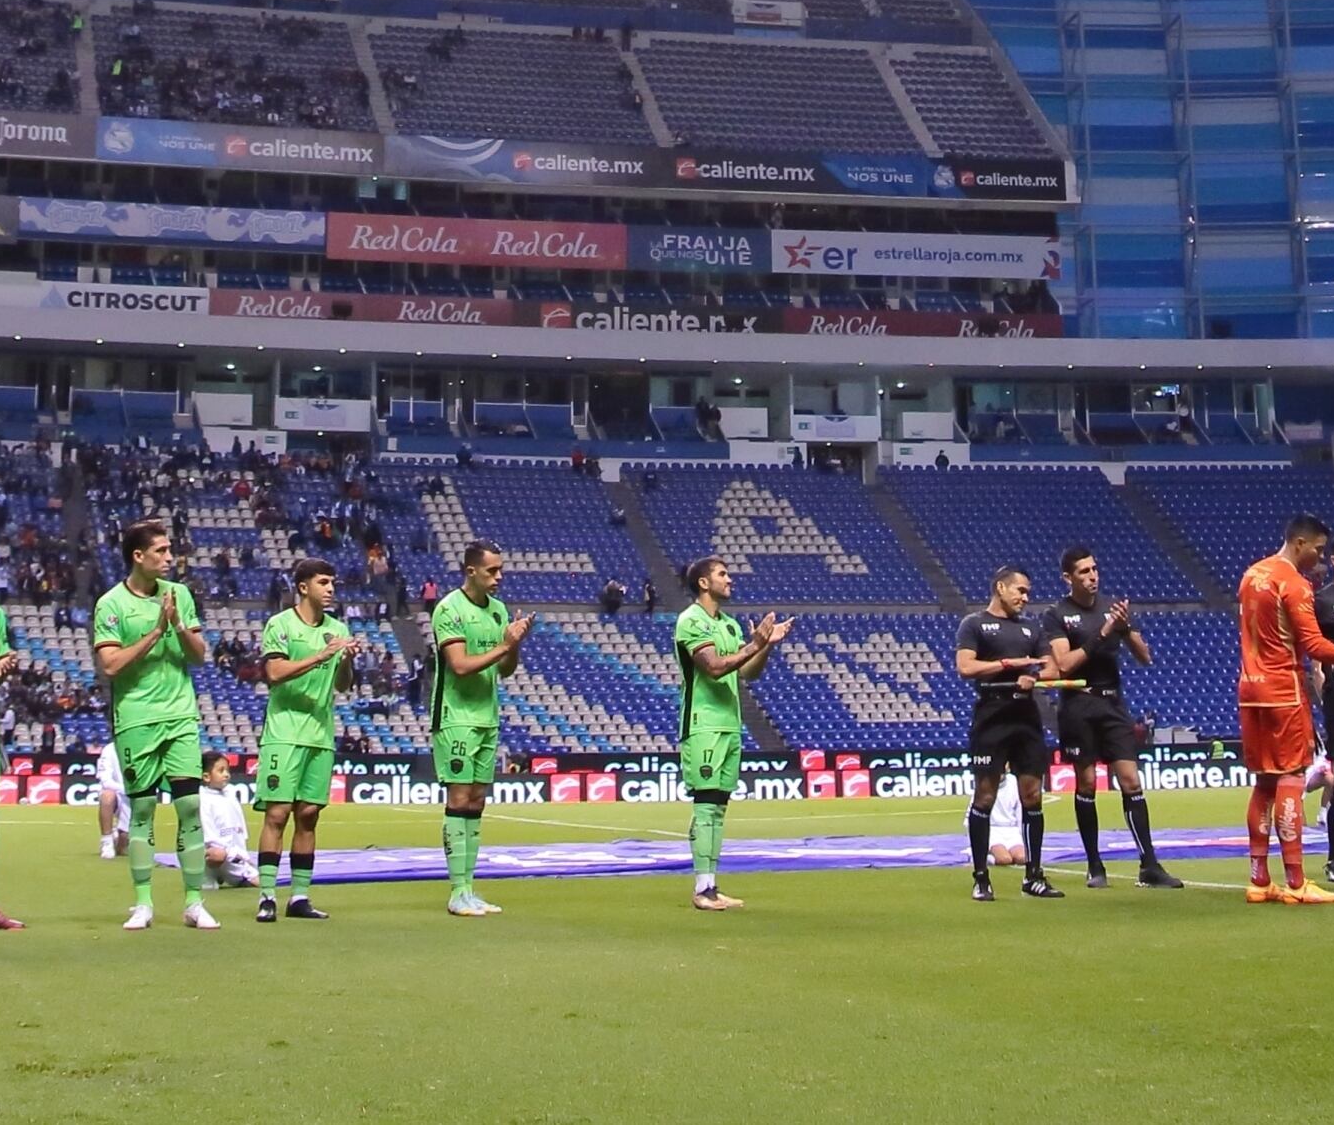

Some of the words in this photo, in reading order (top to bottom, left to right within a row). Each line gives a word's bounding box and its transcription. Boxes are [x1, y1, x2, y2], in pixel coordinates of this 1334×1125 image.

[250, 139, 373, 163] caliente.mx
[534, 153, 643, 175] caliente.mx
[700, 159, 815, 182] caliente.mx
[976, 172, 1058, 187] caliente.mx
[822, 245, 858, 270] er
[874, 246, 1024, 264] estrellaroja.com.mx
[67, 290, 201, 312] CITROSCUT
[124, 748, 132, 764] 9
[451, 740, 466, 756] 26
[270, 754, 278, 770] 5
[703, 749, 714, 764] 17
[973, 755, 992, 765] FMF
